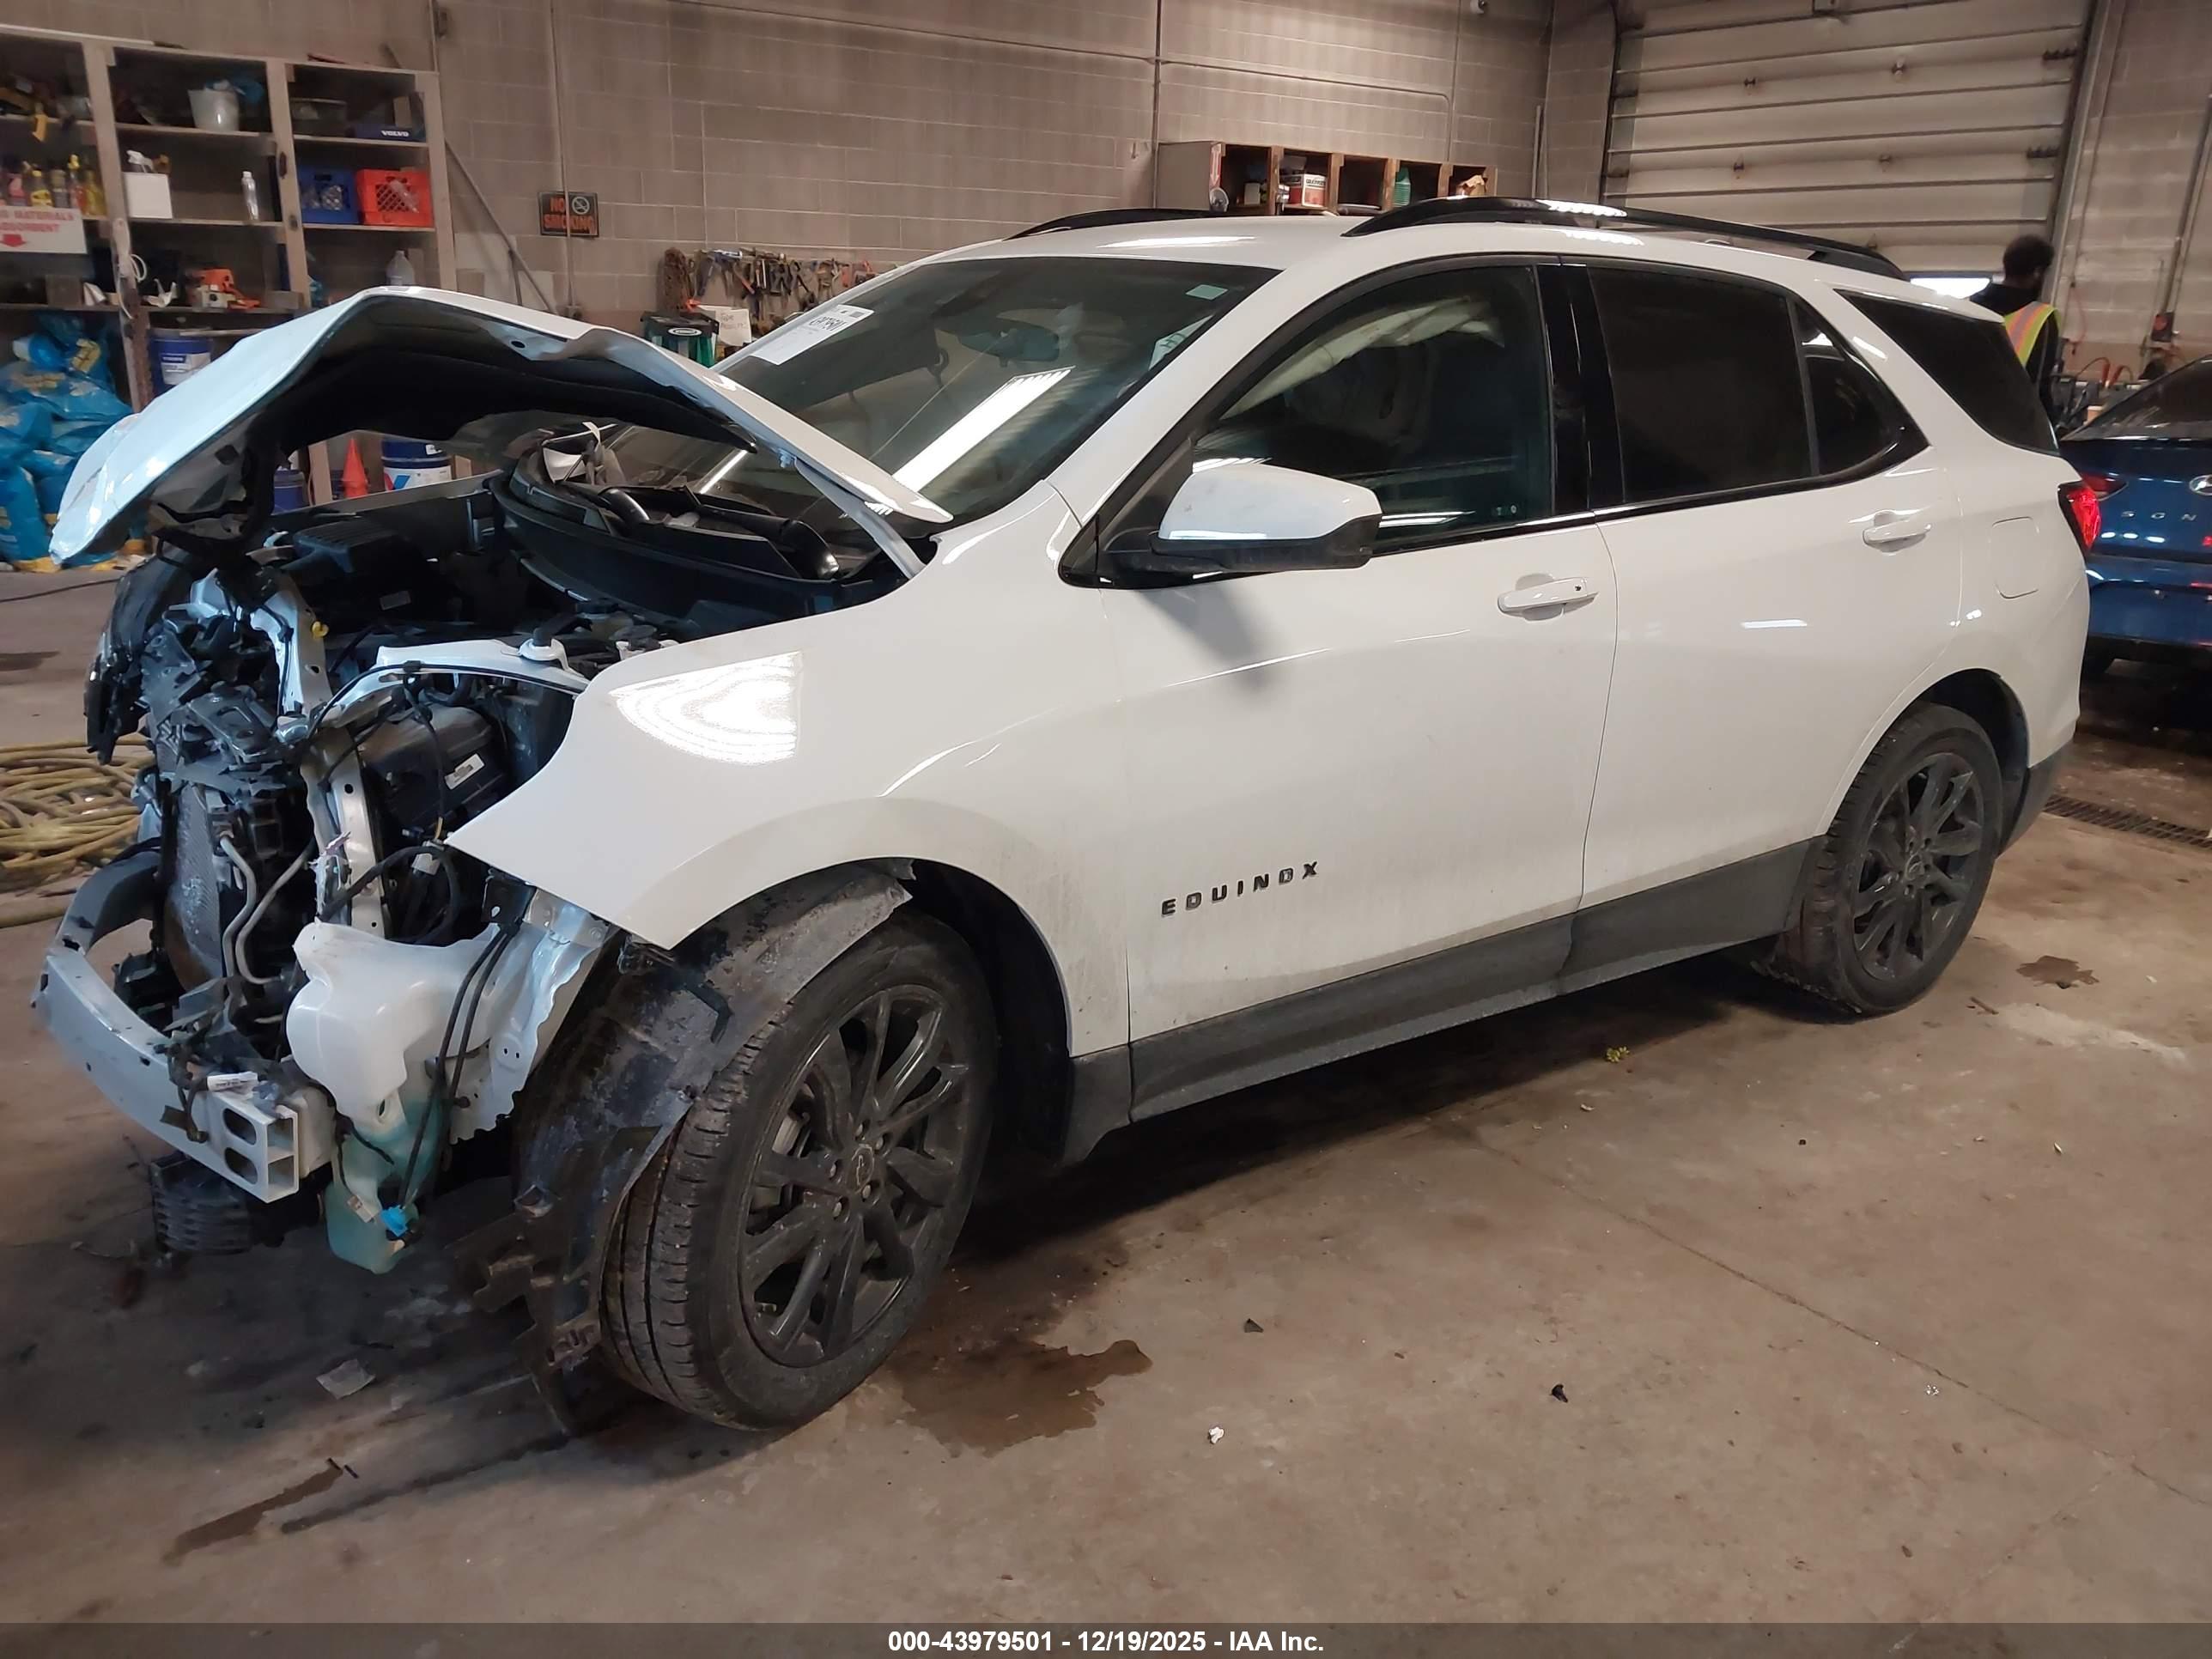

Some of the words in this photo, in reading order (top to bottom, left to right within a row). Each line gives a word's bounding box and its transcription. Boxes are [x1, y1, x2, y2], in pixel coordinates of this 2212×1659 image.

[550, 197, 566, 212] NO
[543, 213, 594, 231] SMOKING
[1161, 860, 1318, 917] EQUINOX
